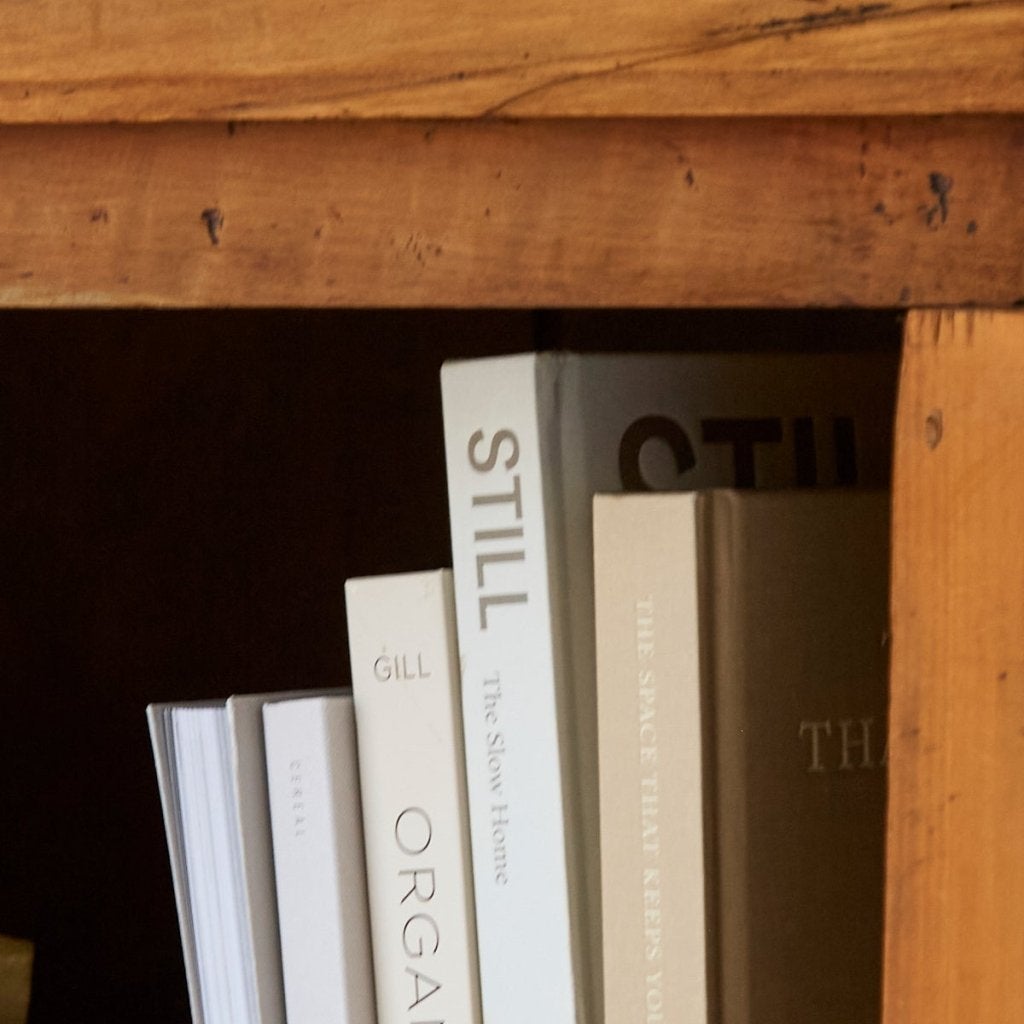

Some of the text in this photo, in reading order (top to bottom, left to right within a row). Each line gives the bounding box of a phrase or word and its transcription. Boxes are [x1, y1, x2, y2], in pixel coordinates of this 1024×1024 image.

[467, 428, 529, 631] STILL
[373, 652, 432, 683] GILL
[636, 596, 656, 660] THE
[638, 668, 658, 765] SPACE
[798, 716, 889, 774] TH
[480, 671, 510, 887] The Slow Home
[640, 772, 662, 857] THAT
[643, 867, 663, 961] KEEPS
